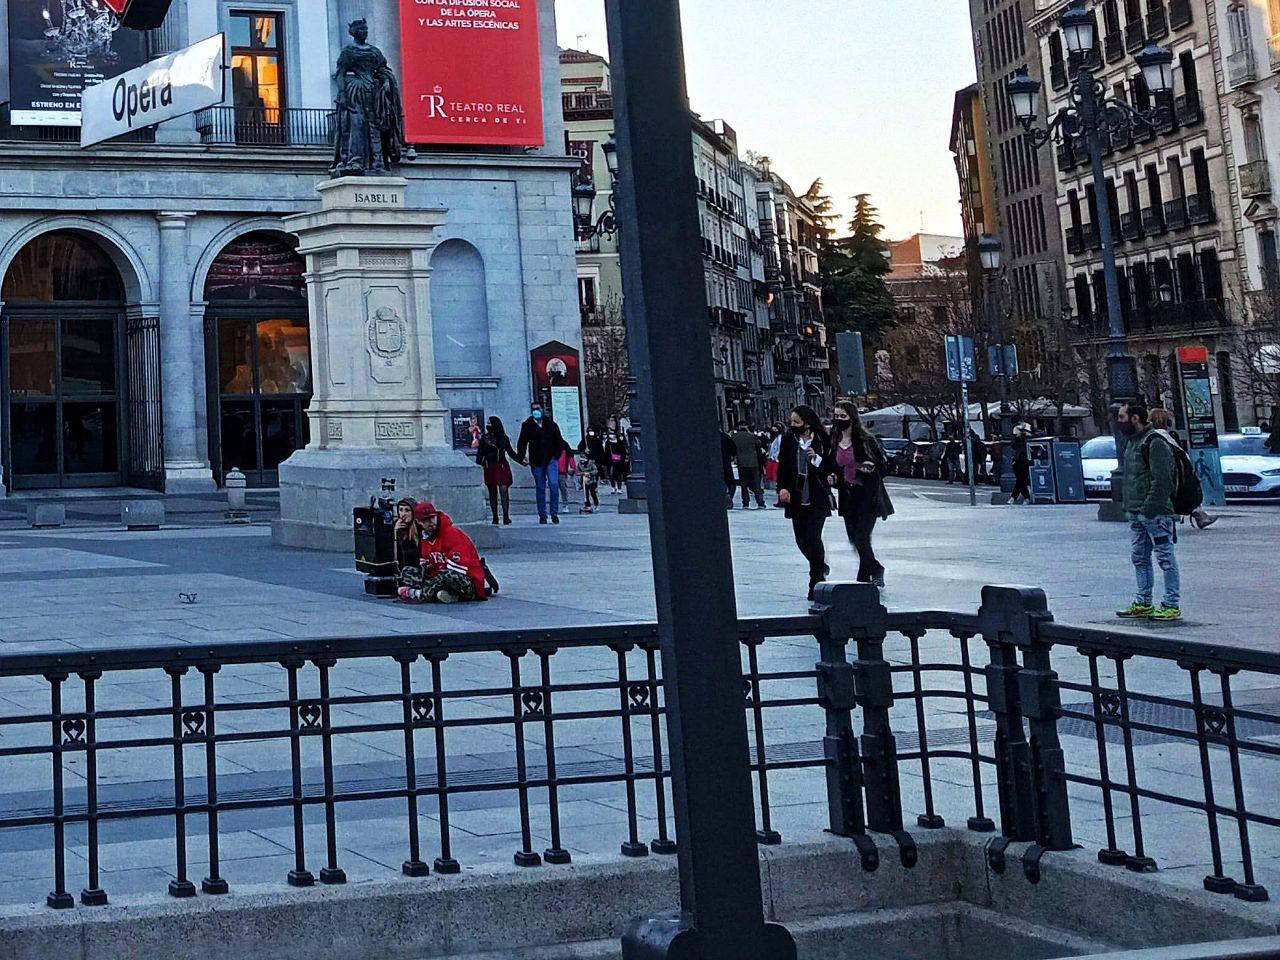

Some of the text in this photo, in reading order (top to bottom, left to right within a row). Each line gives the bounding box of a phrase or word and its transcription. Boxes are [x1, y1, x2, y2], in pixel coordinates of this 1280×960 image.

[490, 0, 520, 8] SOCIAL
[440, 7, 496, 18] DE LA ÓPERA
[418, 18, 426, 26] Y
[426, 19, 443, 27] LAS
[445, 19, 472, 28] ARTES
[113, 75, 173, 128] Opera
[450, 102, 525, 113] TEATRO REAL
[354, 193, 398, 203] ISABEL II
